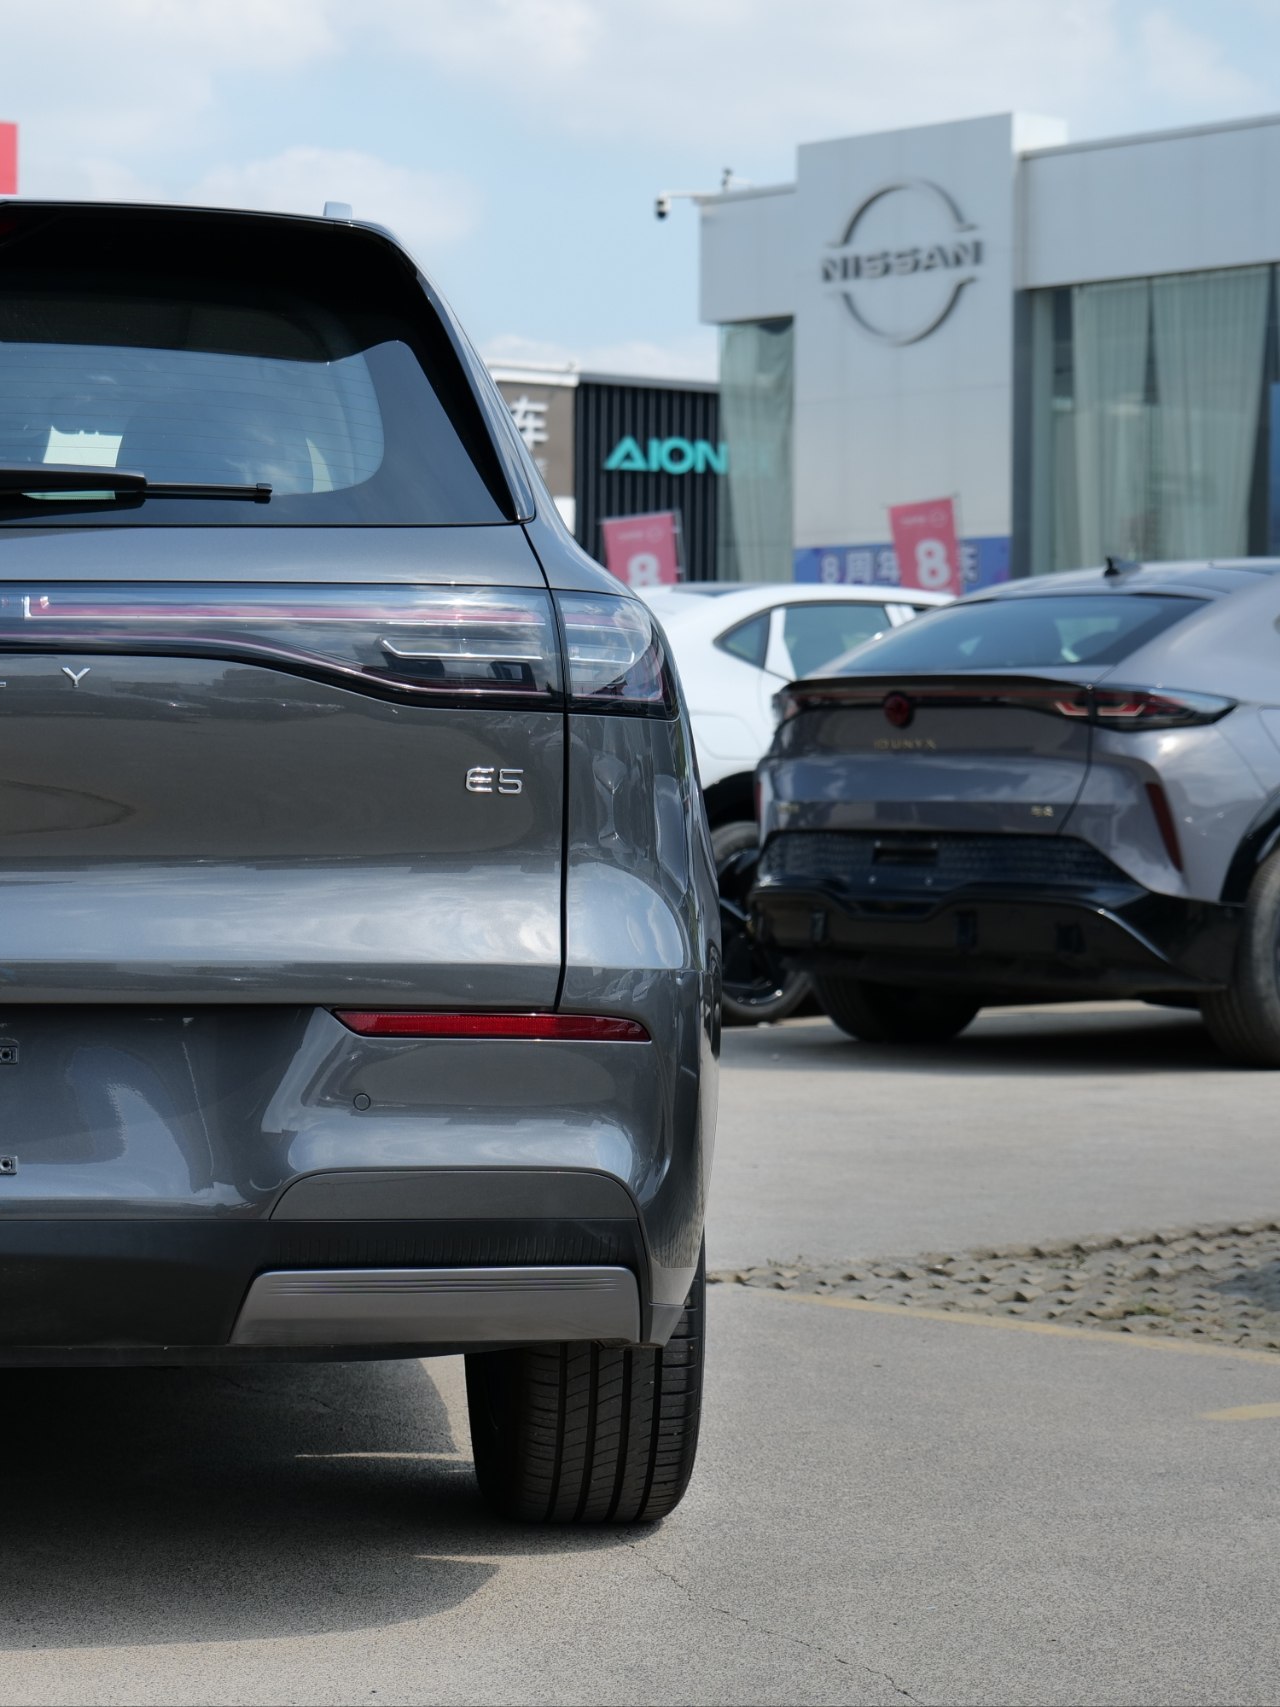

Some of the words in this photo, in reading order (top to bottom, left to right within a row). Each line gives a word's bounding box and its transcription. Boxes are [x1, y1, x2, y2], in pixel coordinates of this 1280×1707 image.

[821, 239, 984, 284] NISSAN
[603, 434, 729, 475] AION
[915, 537, 952, 589] 8
[465, 765, 524, 794] E5
